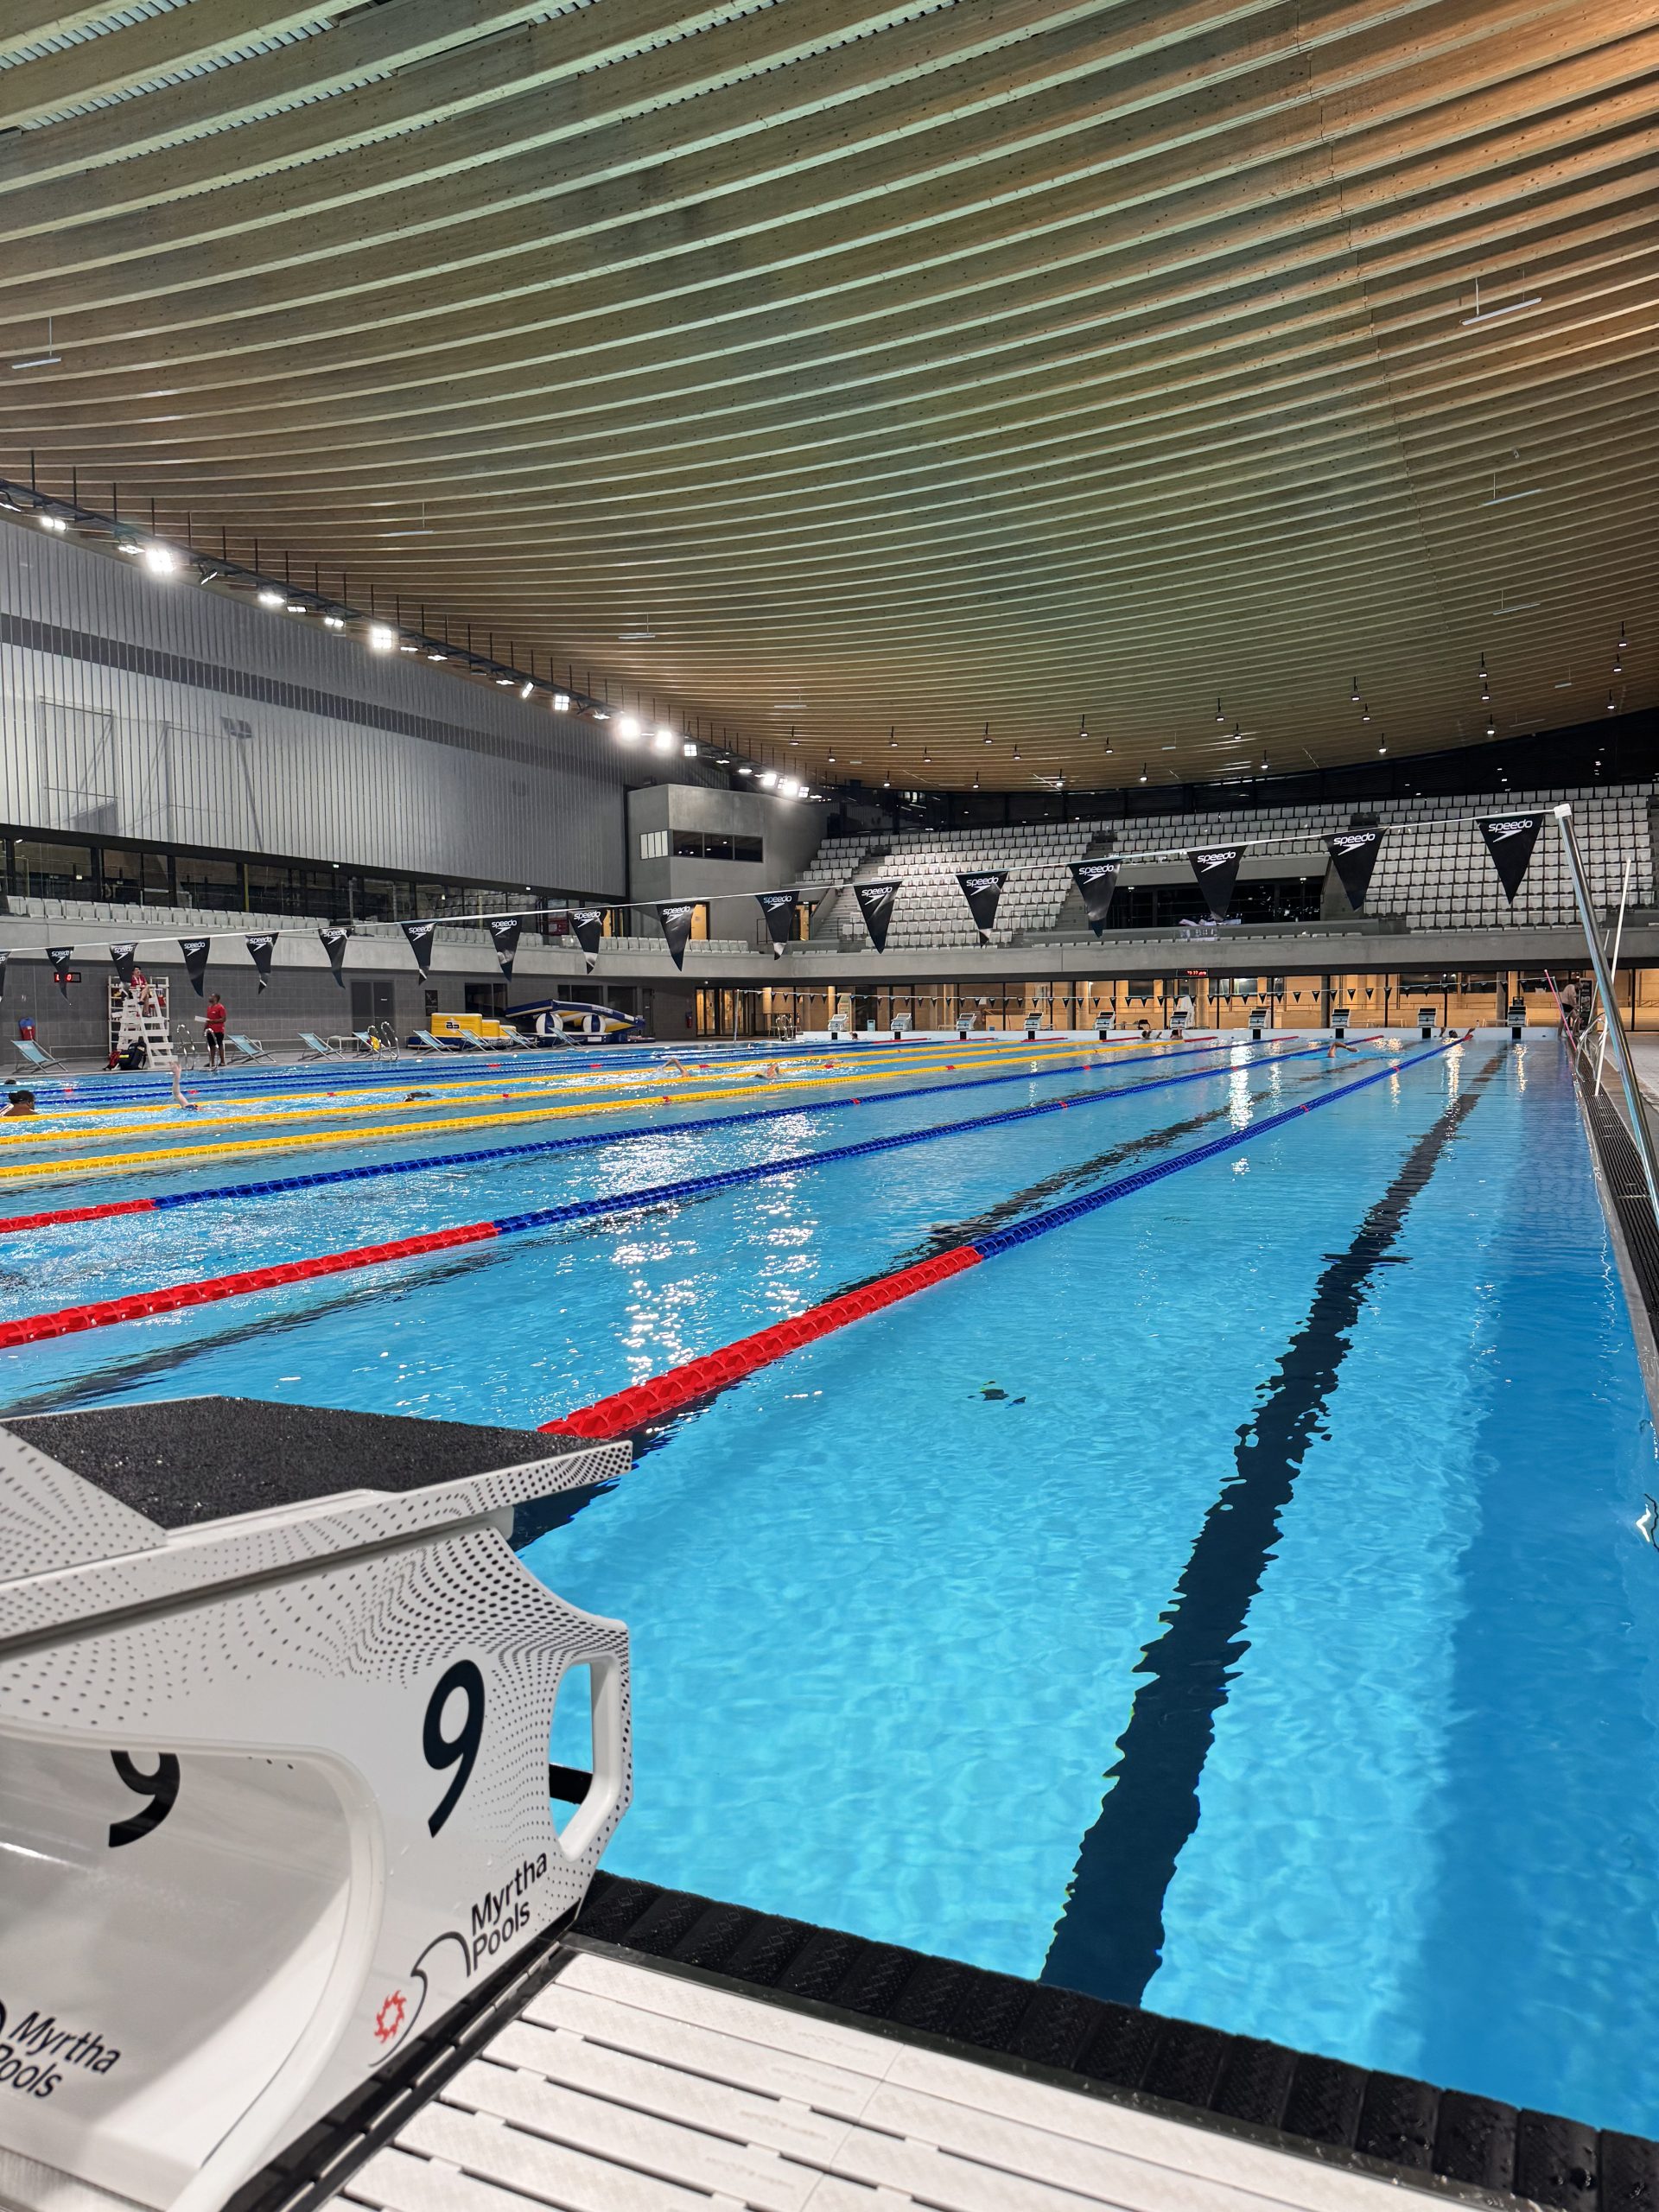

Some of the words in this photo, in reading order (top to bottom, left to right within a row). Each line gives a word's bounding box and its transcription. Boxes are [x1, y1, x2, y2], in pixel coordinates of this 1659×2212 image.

[1488, 819, 1533, 833] speedo
[1333, 832, 1376, 846] speedo
[1197, 851, 1236, 864] speedo
[1078, 863, 1114, 876] speedo
[966, 875, 999, 887] speedo
[861, 886, 893, 897] speedo
[763, 894, 792, 905] speedo
[574, 910, 601, 920] speedo
[663, 905, 690, 916] speedo
[491, 918, 517, 928] speedo
[323, 928, 347, 938] speedo
[184, 941, 206, 950] speedo
[250, 936, 272, 944] speedo
[423, 1659, 486, 1838] 9
[472, 1852, 547, 1936] Myrtha
[473, 1901, 531, 1971] Pools
[8, 2010, 121, 2075] Myrtha
